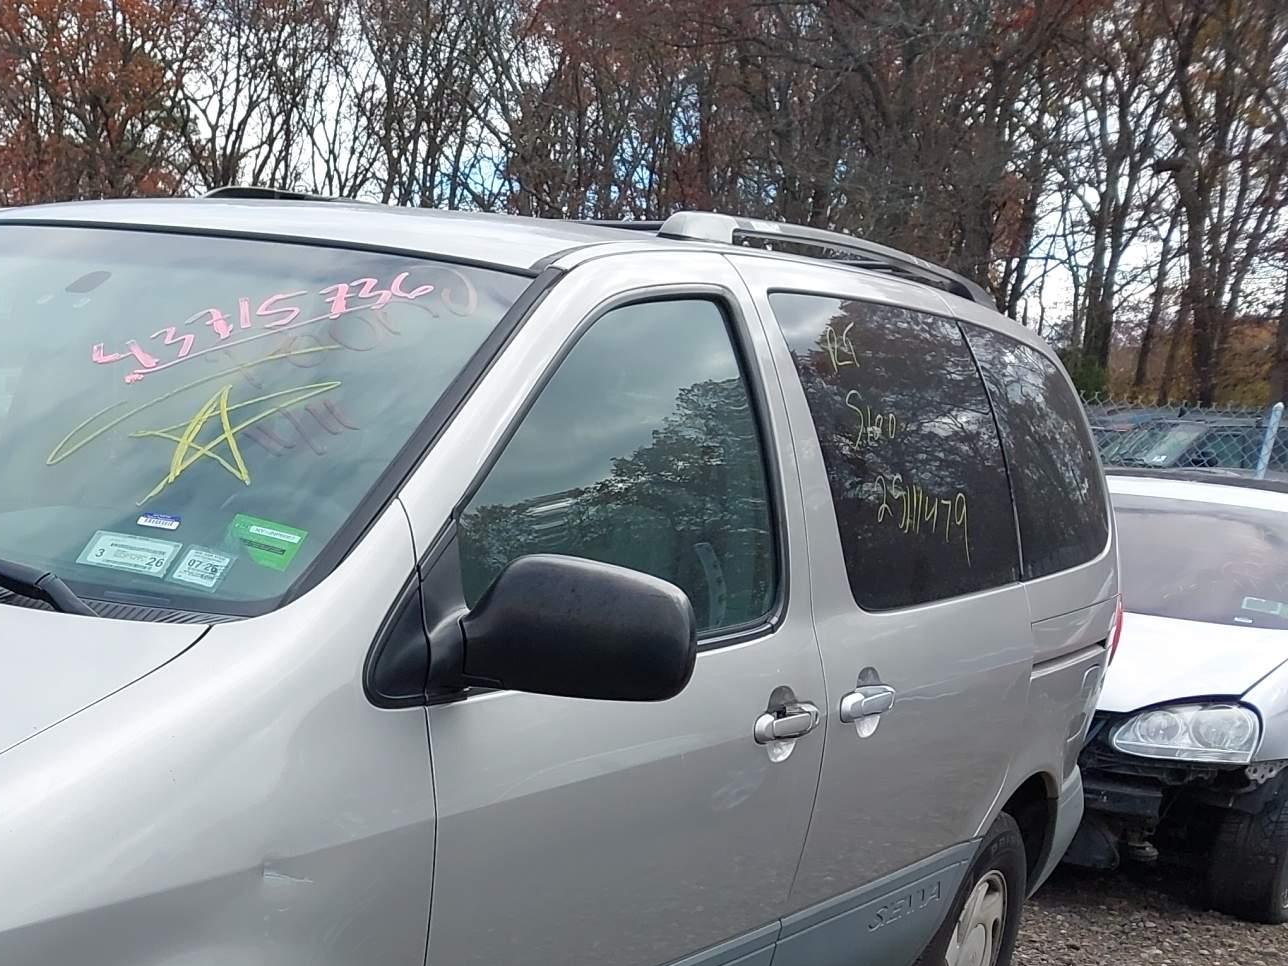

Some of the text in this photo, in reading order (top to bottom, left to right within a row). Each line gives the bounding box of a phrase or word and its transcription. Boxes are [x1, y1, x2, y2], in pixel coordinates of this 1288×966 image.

[92, 272, 435, 369] 43715736
[95, 548, 106, 558] 3
[145, 556, 165, 569] 26
